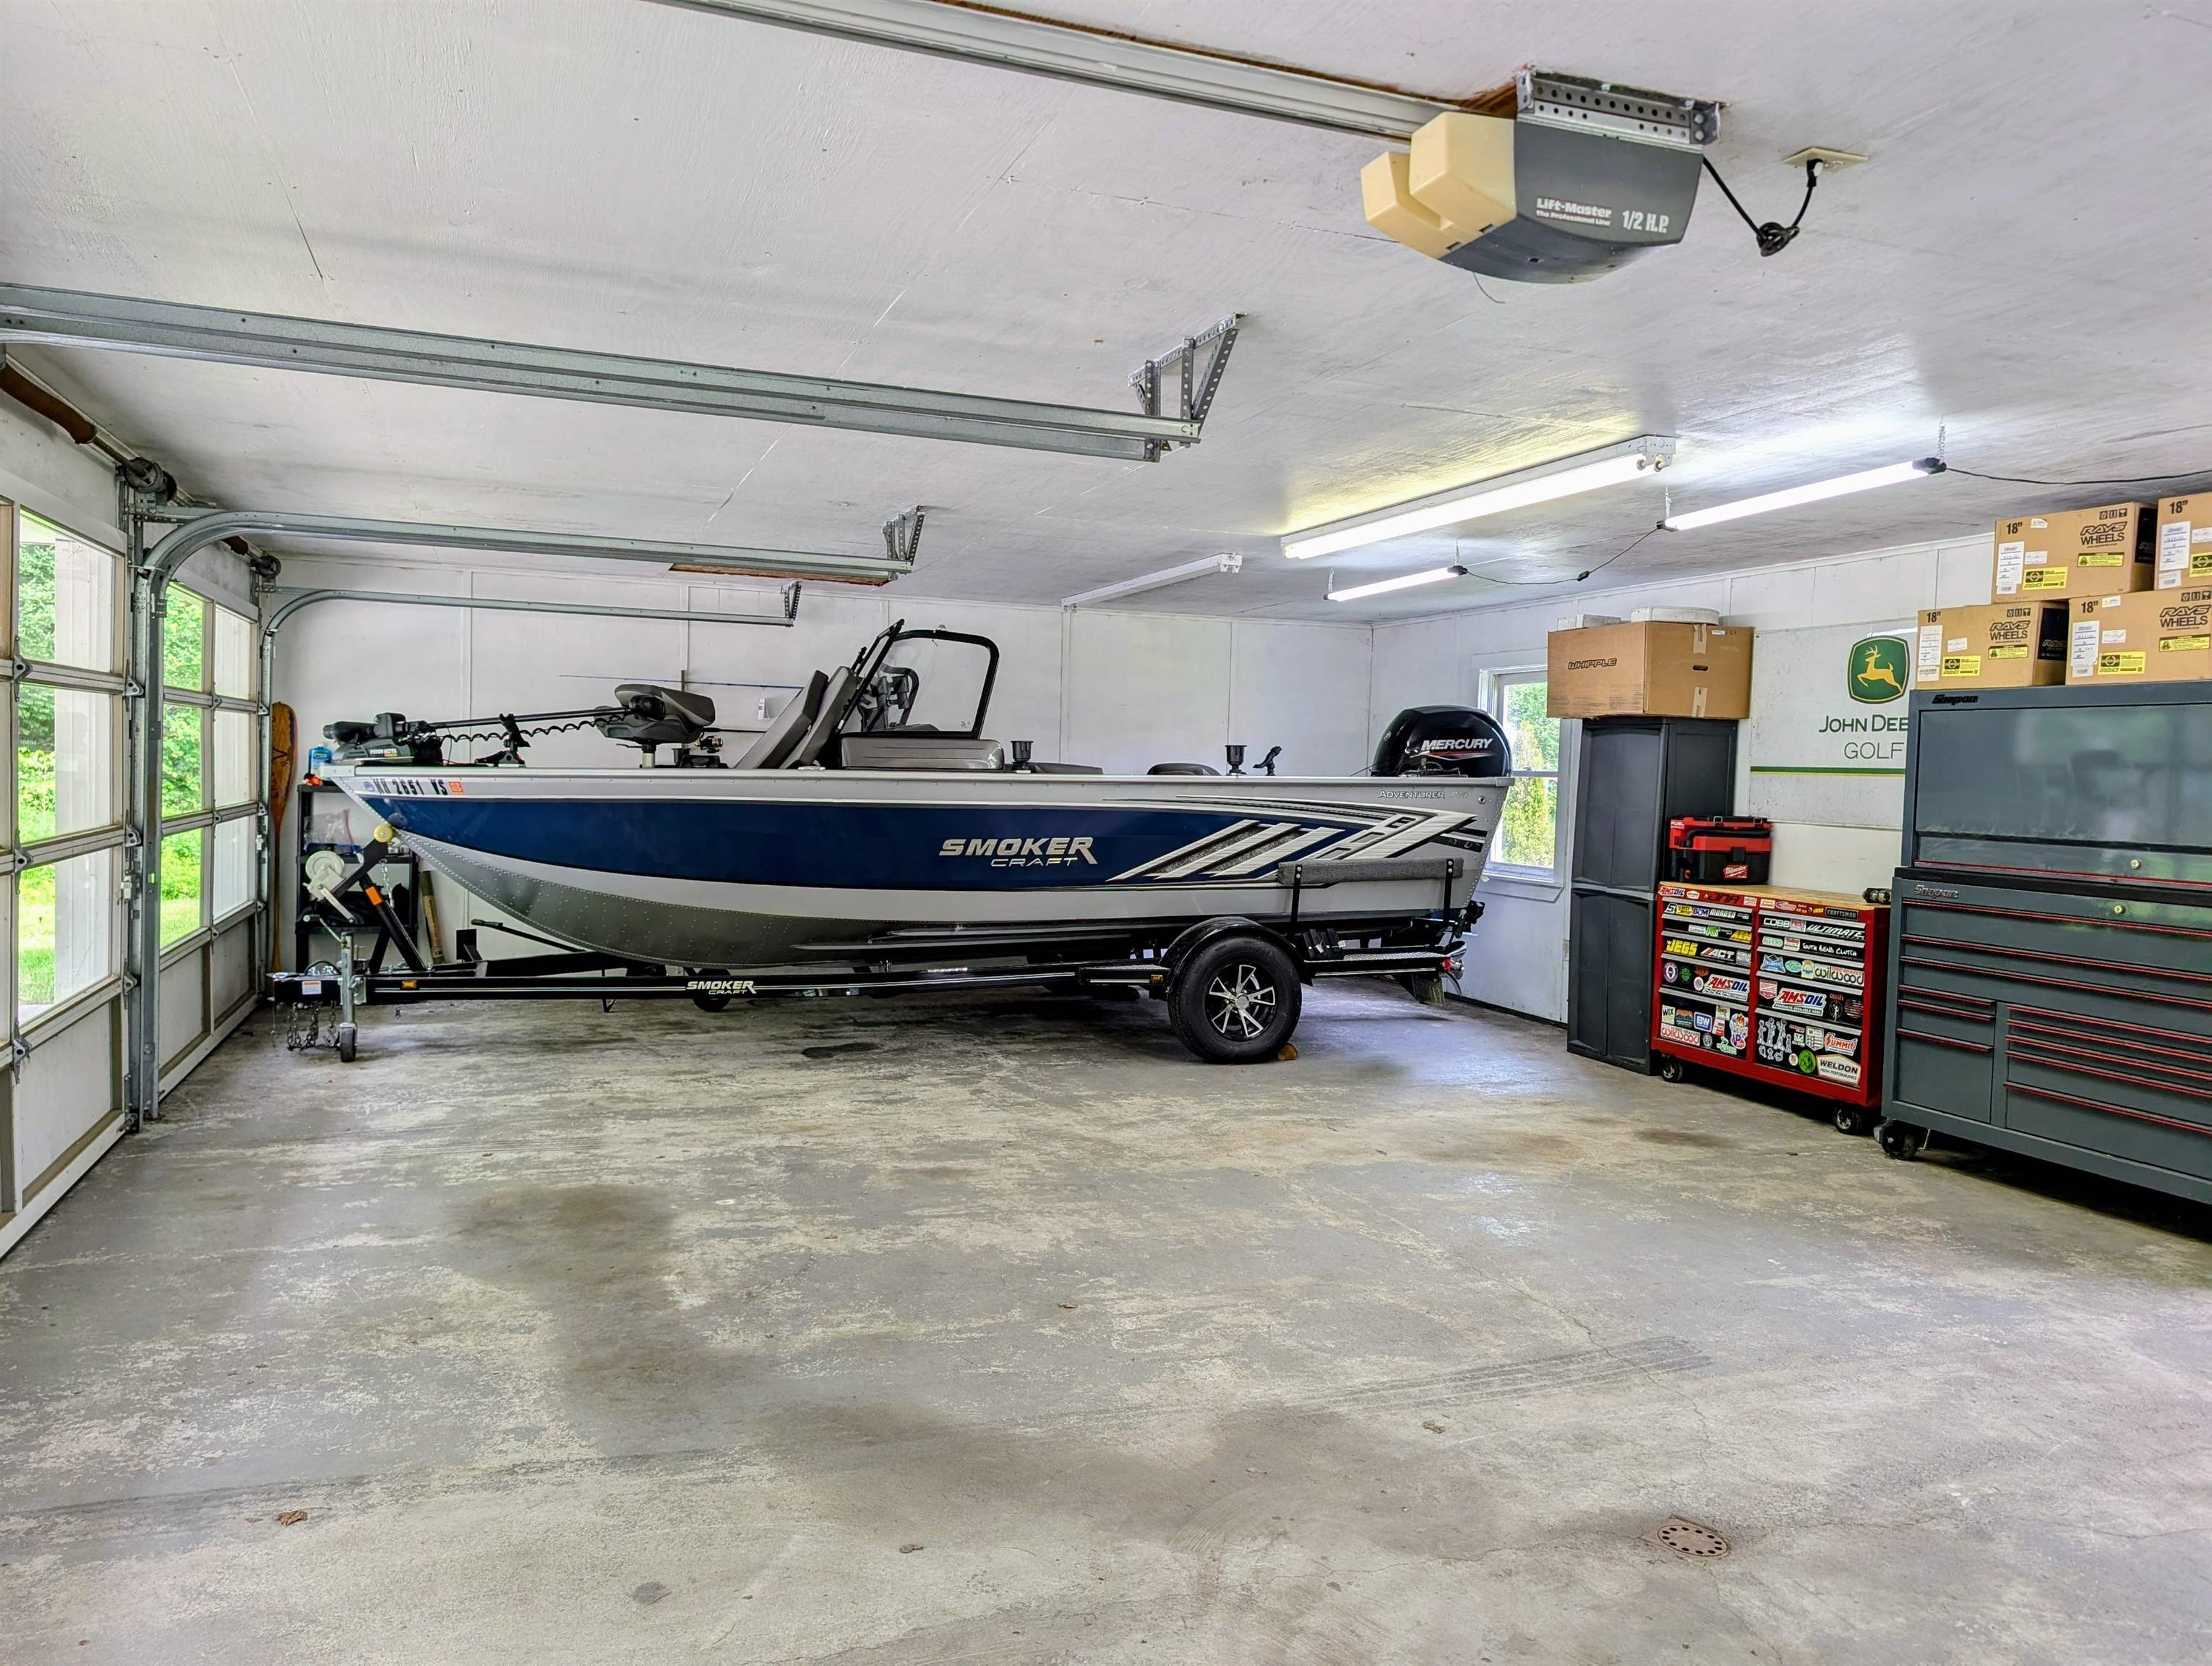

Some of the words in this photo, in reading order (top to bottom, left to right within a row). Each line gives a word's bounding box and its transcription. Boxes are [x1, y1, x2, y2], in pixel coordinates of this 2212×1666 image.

[1536, 198, 1612, 218] Lift-Master
[1551, 212, 1595, 225] Professional
[1622, 210, 1643, 230] 1/2
[2169, 500, 2188, 515] 18"
[2006, 521, 2023, 534] 18"
[2080, 521, 2127, 536] RAYS
[2080, 532, 2125, 546] WHEELS
[2080, 600, 2099, 613] 18"
[2159, 605, 2212, 618] RAYS
[1926, 611, 1942, 623] 18"
[2160, 615, 2208, 628] WHEELS
[1989, 620, 2031, 631] RAYS
[1990, 631, 2028, 641] WHEELS
[1568, 658, 1618, 670] WHIPPLE
[1819, 715, 1868, 732] JOHN
[1872, 714, 1908, 732] DEE
[1421, 738, 1493, 751] MERCURY
[1844, 742, 1905, 759] GOLF
[392, 778, 425, 795] 2651
[1378, 790, 1445, 799] ADVENTURER
[939, 837, 1098, 865] SMOKER
[990, 857, 1079, 867] CRAFT
[1658, 887, 1684, 896] AMSOIL
[1710, 909, 1736, 918] MOROSO
[1827, 910, 1856, 919] CRAFTSMAN
[1764, 918, 1791, 928] COBB
[1807, 924, 1865, 940] ULTIMATE
[1666, 939, 1698, 956] JEGS
[1710, 948, 1735, 959] ACT
[1815, 966, 1864, 985] wilwood
[686, 981, 757, 994] SMOKER
[1708, 976, 1748, 992] AMSOIL
[1778, 991, 1823, 1006] AMSOIL
[1696, 1015, 1710, 1026] BW
[1662, 1027, 1699, 1044] wilwood
[1825, 1034, 1856, 1050] SUMMIT
[1820, 1059, 1858, 1074] WELDON
